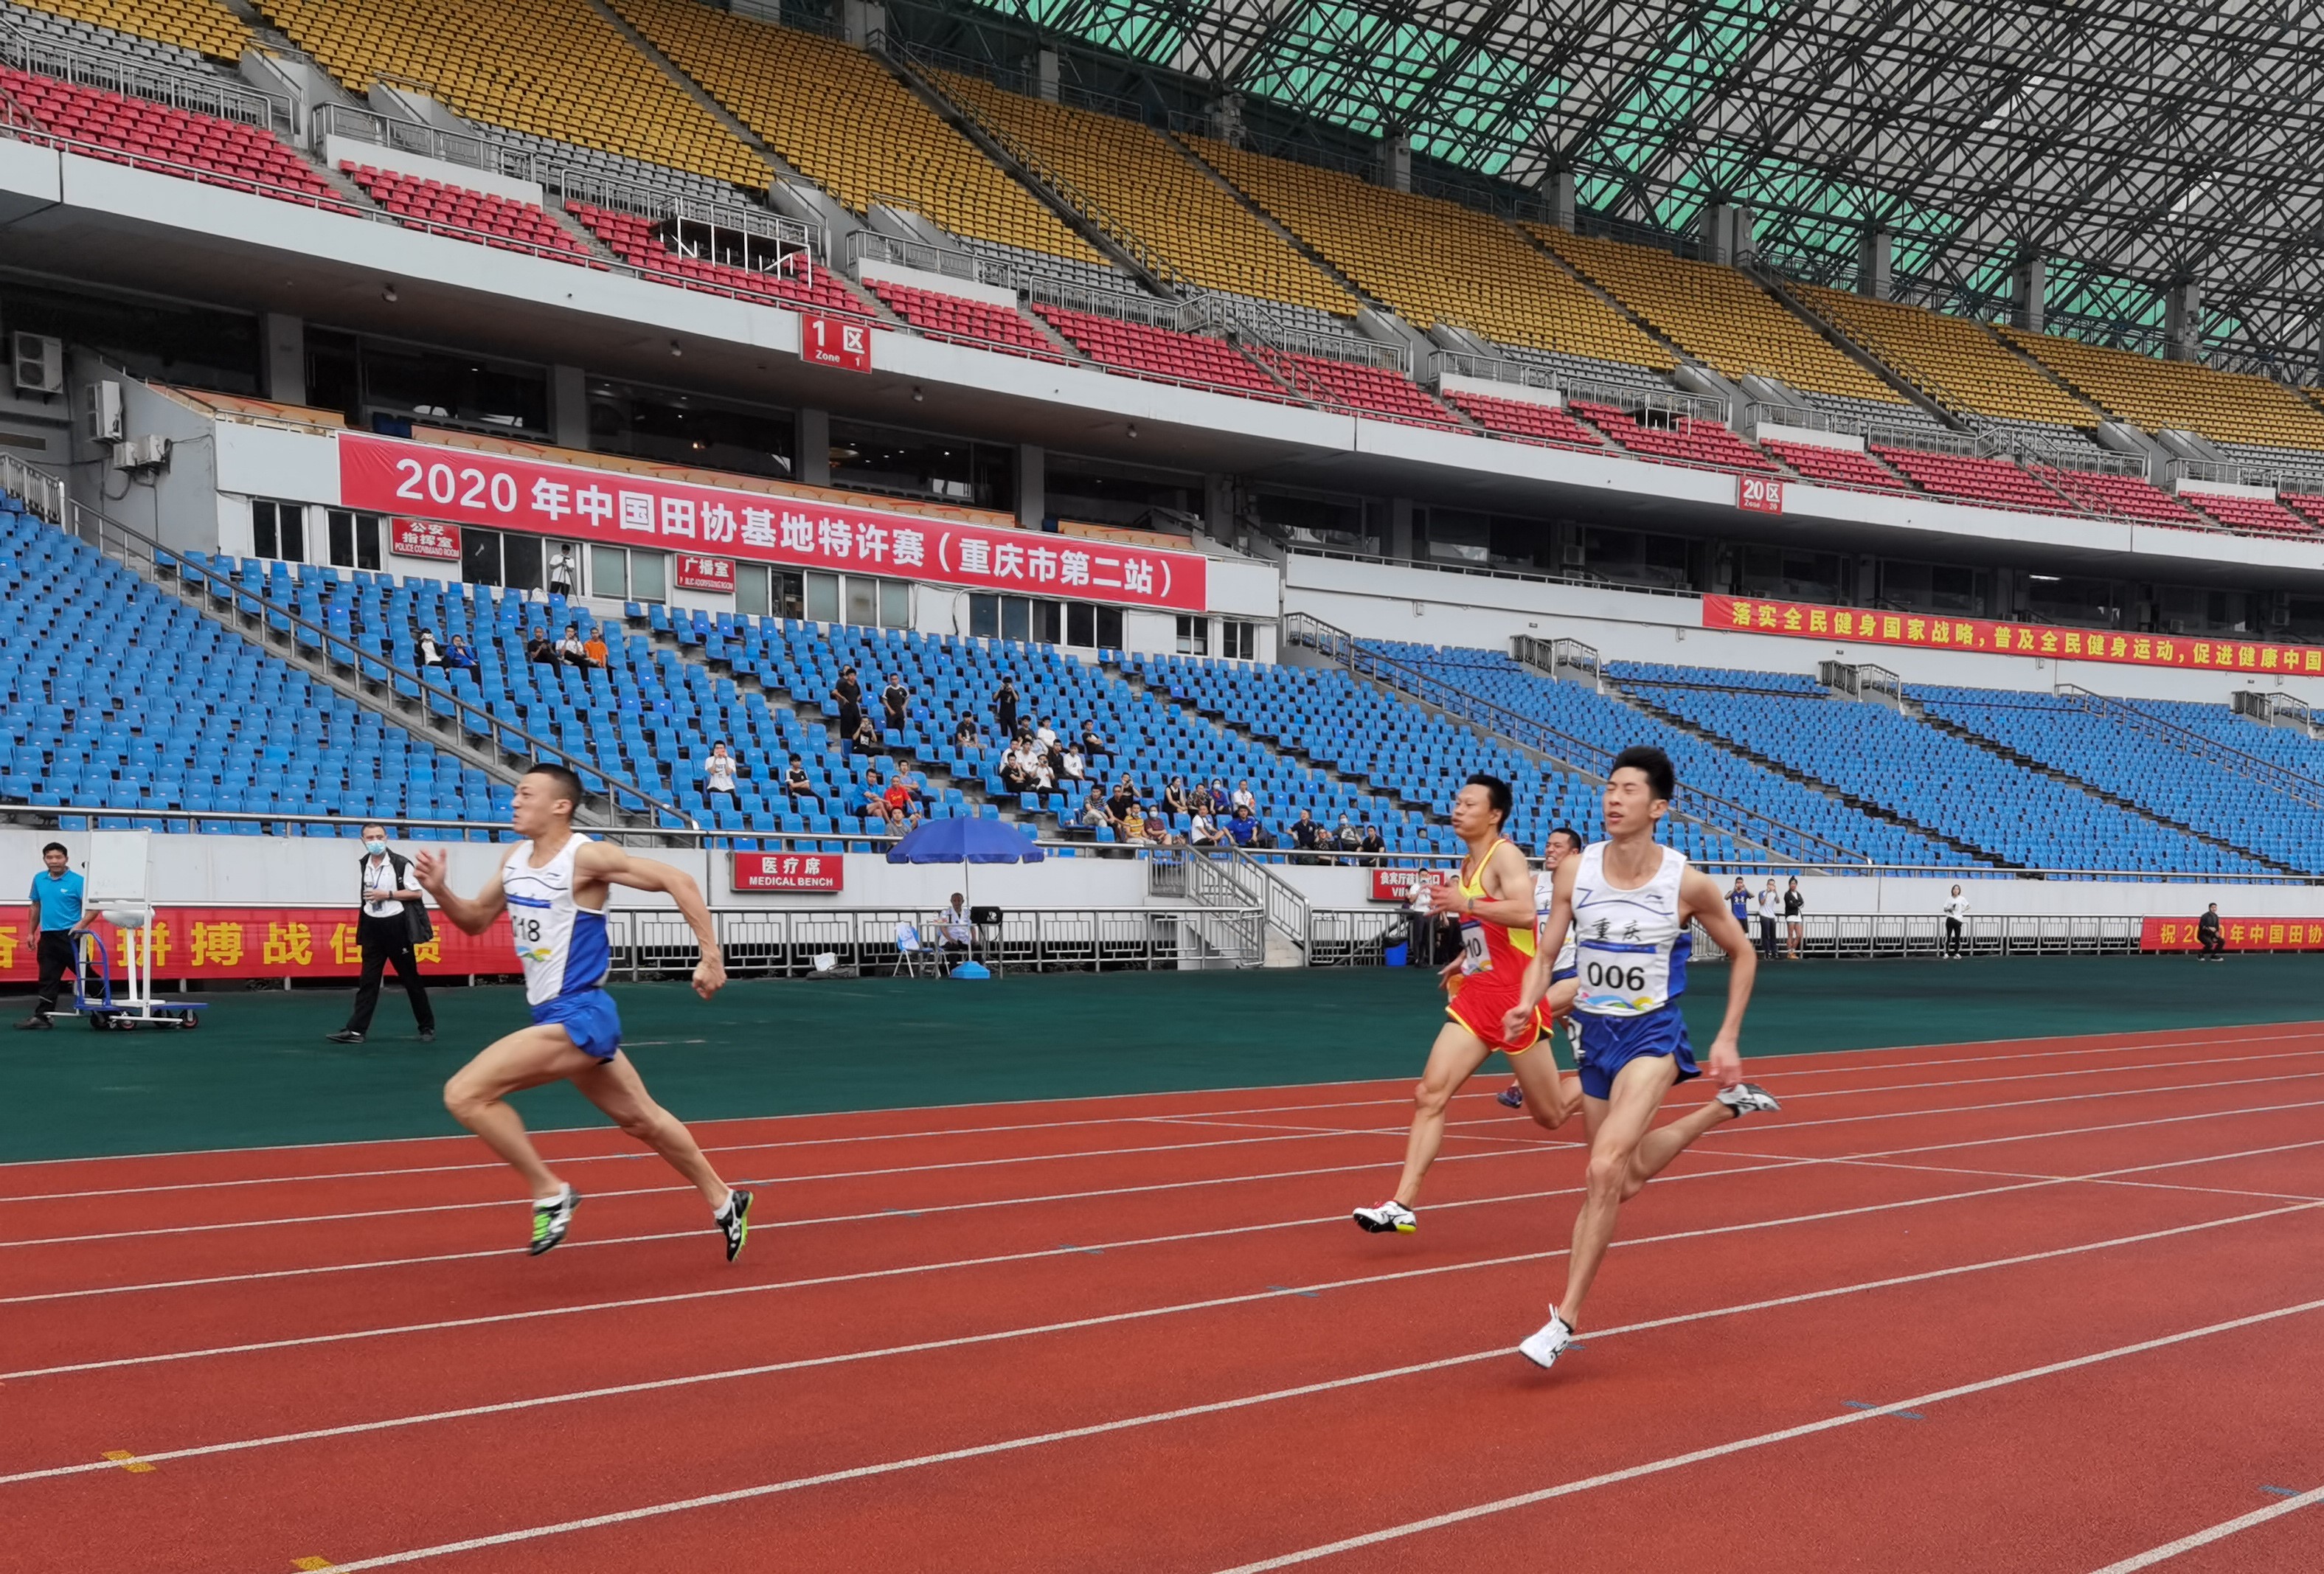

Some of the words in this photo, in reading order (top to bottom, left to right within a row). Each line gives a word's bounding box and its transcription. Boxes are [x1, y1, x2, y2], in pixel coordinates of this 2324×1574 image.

[815, 349, 840, 363] Zone
[855, 357, 860, 367] 1
[410, 521, 444, 535] 公安
[395, 542, 413, 552] POLICE
[402, 532, 453, 549] 指挥室
[684, 557, 729, 578] 广播室
[761, 856, 821, 876] 医疗席
[749, 876, 796, 886] MEDICAL
[797, 877, 833, 887] BENCH
[1592, 917, 1642, 942] 重庆
[1587, 961, 1645, 991] 006
